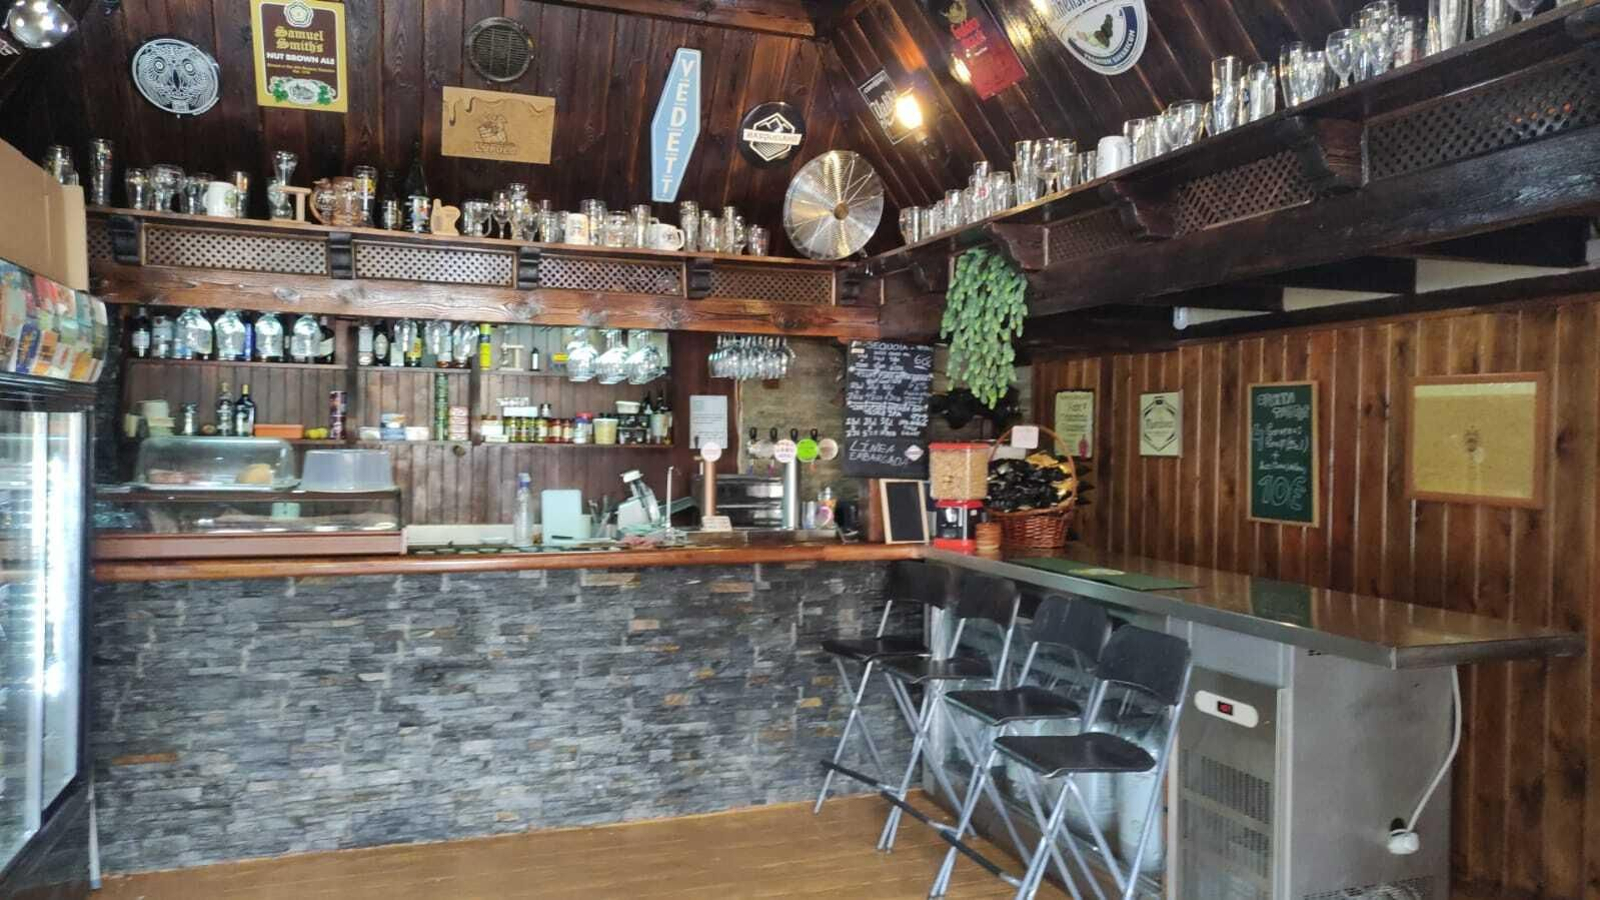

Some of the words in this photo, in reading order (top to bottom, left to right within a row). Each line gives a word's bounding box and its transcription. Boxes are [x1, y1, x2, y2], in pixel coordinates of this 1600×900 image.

[274, 26, 324, 41] Samuel
[266, 52, 285, 60] NUT
[285, 53, 319, 63] BROWN
[320, 57, 335, 65] ALE
[661, 58, 695, 194] VEDETT
